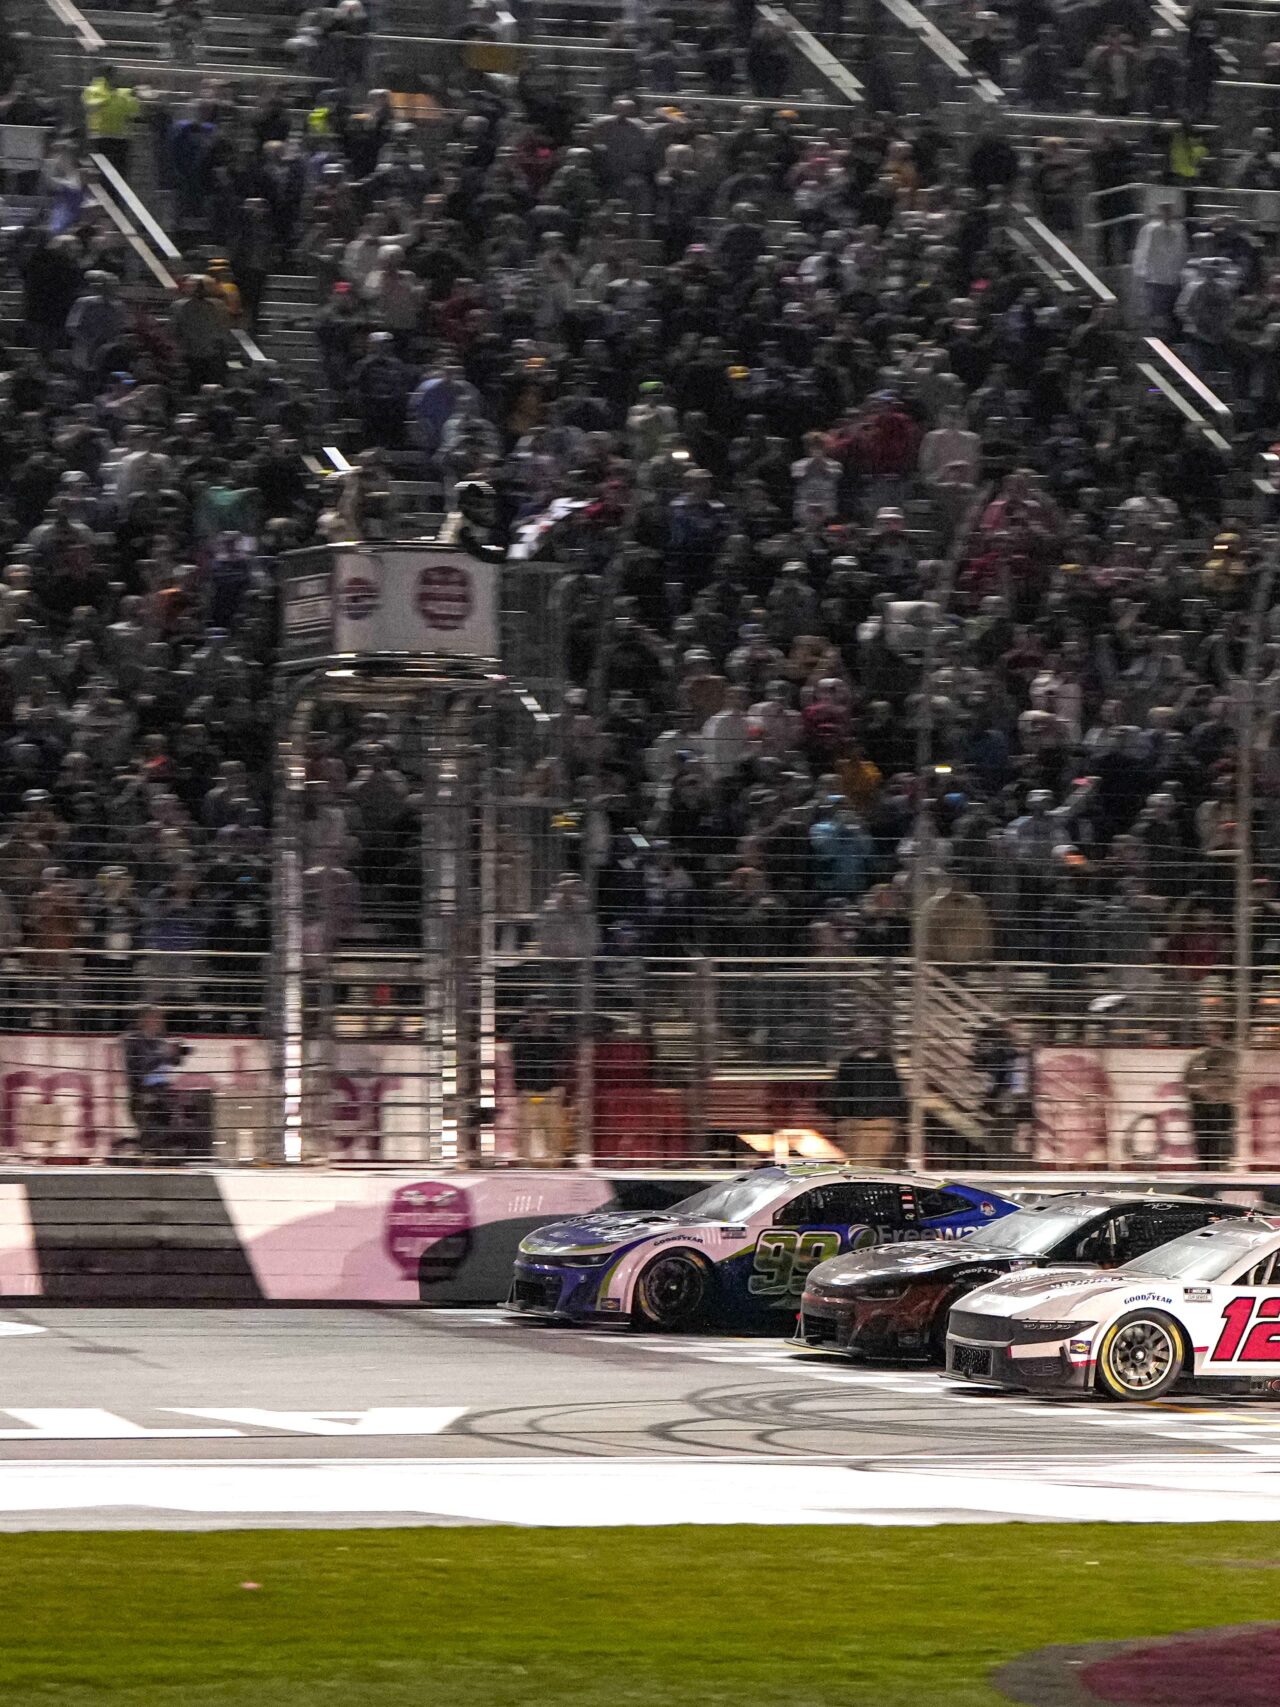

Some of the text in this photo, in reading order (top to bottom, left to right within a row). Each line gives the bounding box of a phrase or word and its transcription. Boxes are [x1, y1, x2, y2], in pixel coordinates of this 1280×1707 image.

[654, 1234, 703, 1246] GOODYEAR
[877, 1225, 984, 1241] Freewa
[748, 1231, 841, 1295] 99
[1124, 1292, 1172, 1304] GOODYEAR
